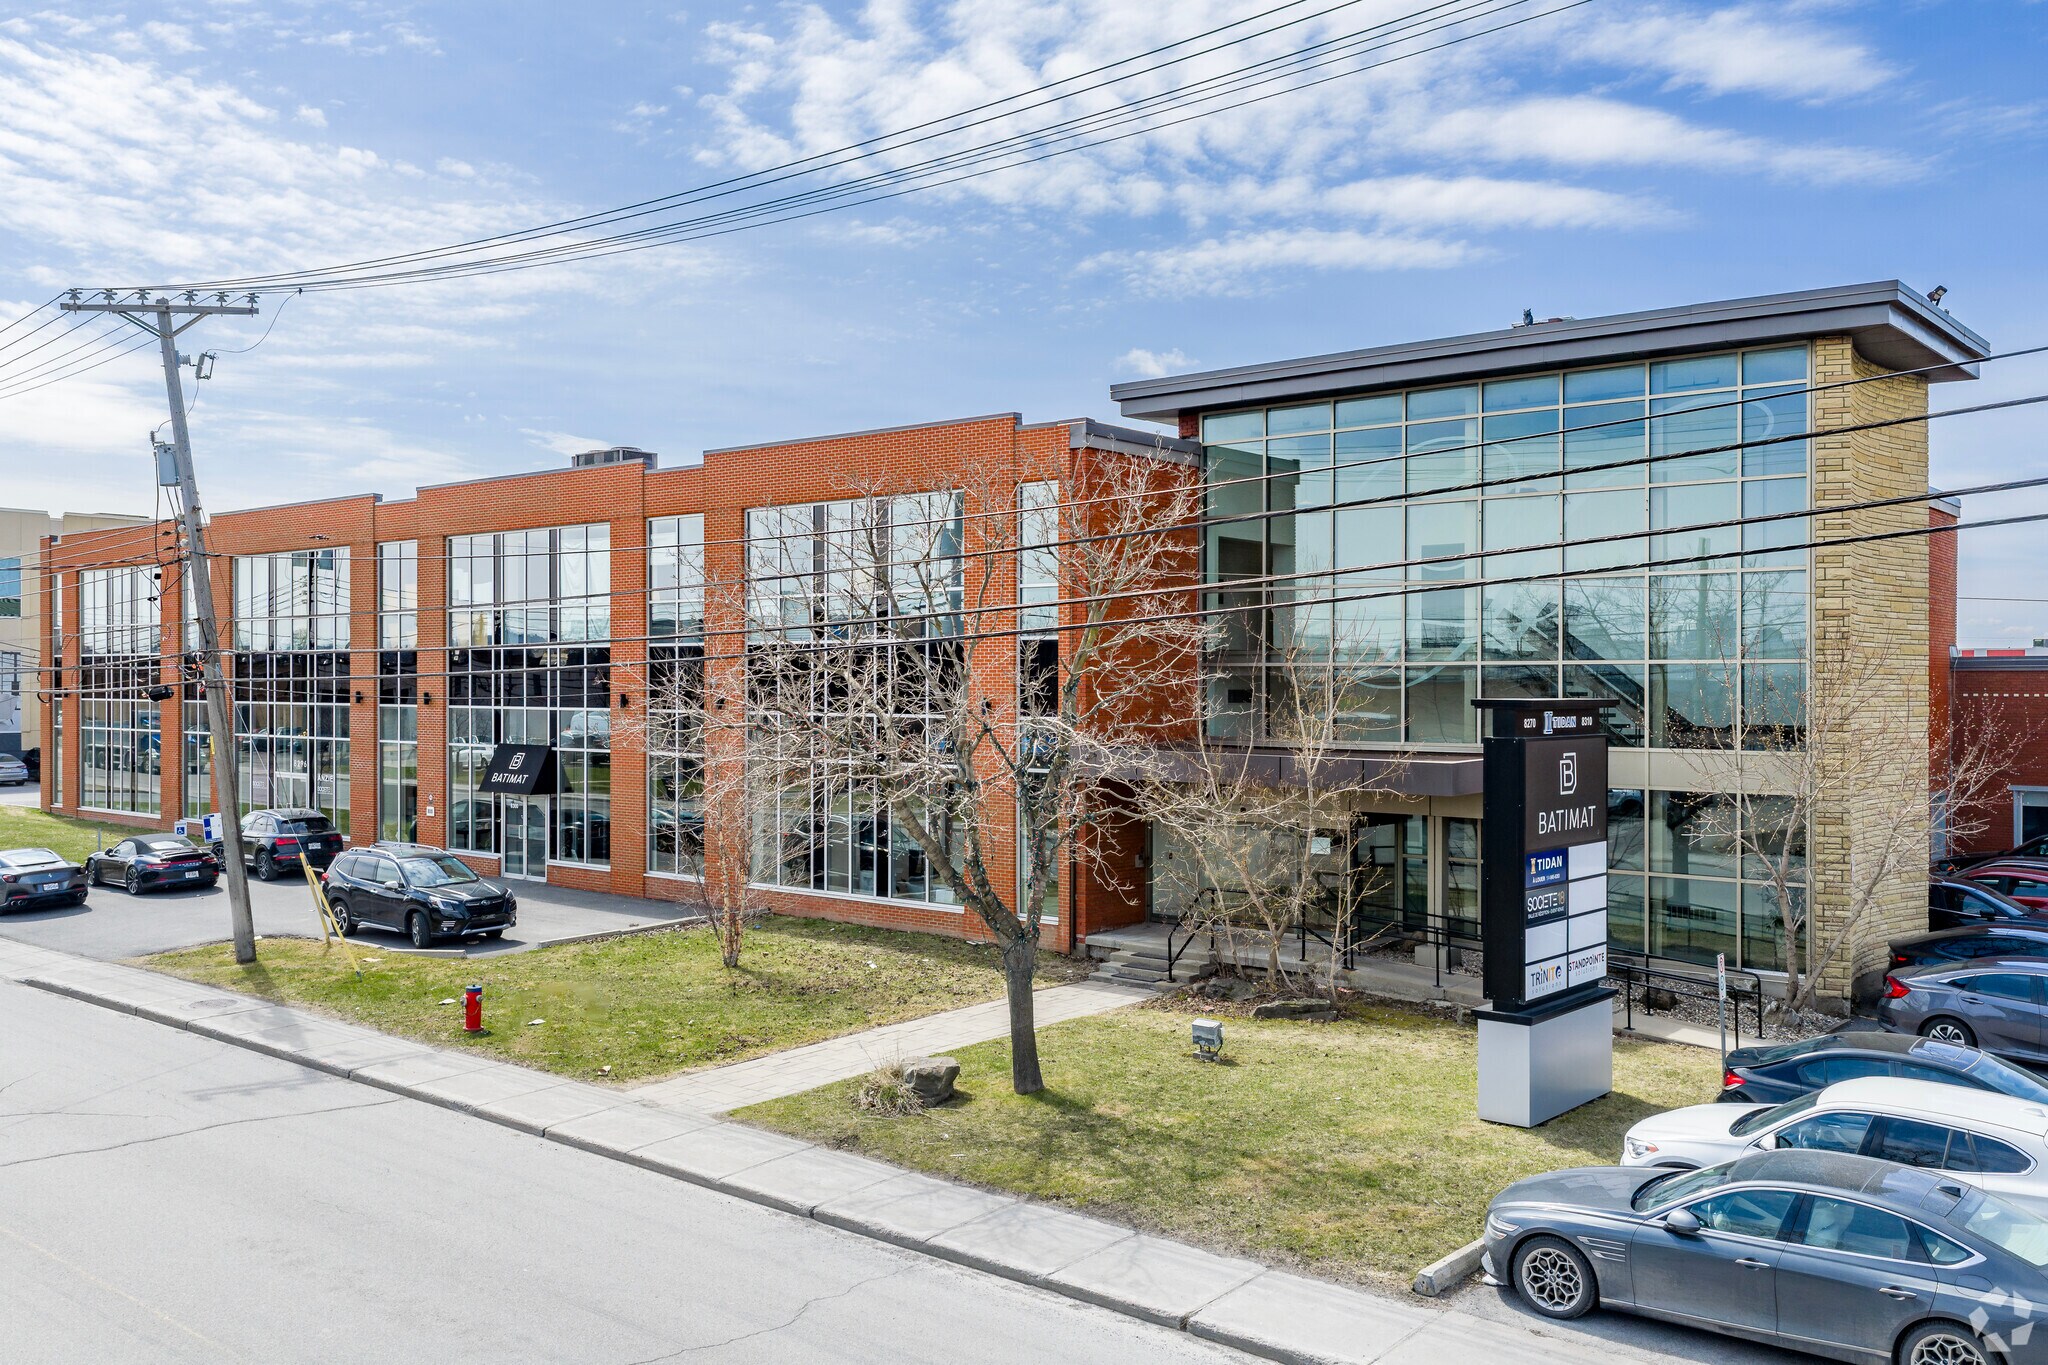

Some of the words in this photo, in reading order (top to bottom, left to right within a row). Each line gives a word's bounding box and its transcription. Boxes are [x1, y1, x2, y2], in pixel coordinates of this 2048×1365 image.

[1523, 718, 1537, 729] 8270
[1552, 715, 1577, 729] TIDAN
[1581, 716, 1593, 726] 8310
[491, 772, 529, 785] BATIMAT
[1538, 805, 1596, 835] BATIMAT
[1537, 855, 1563, 871] TIDAN
